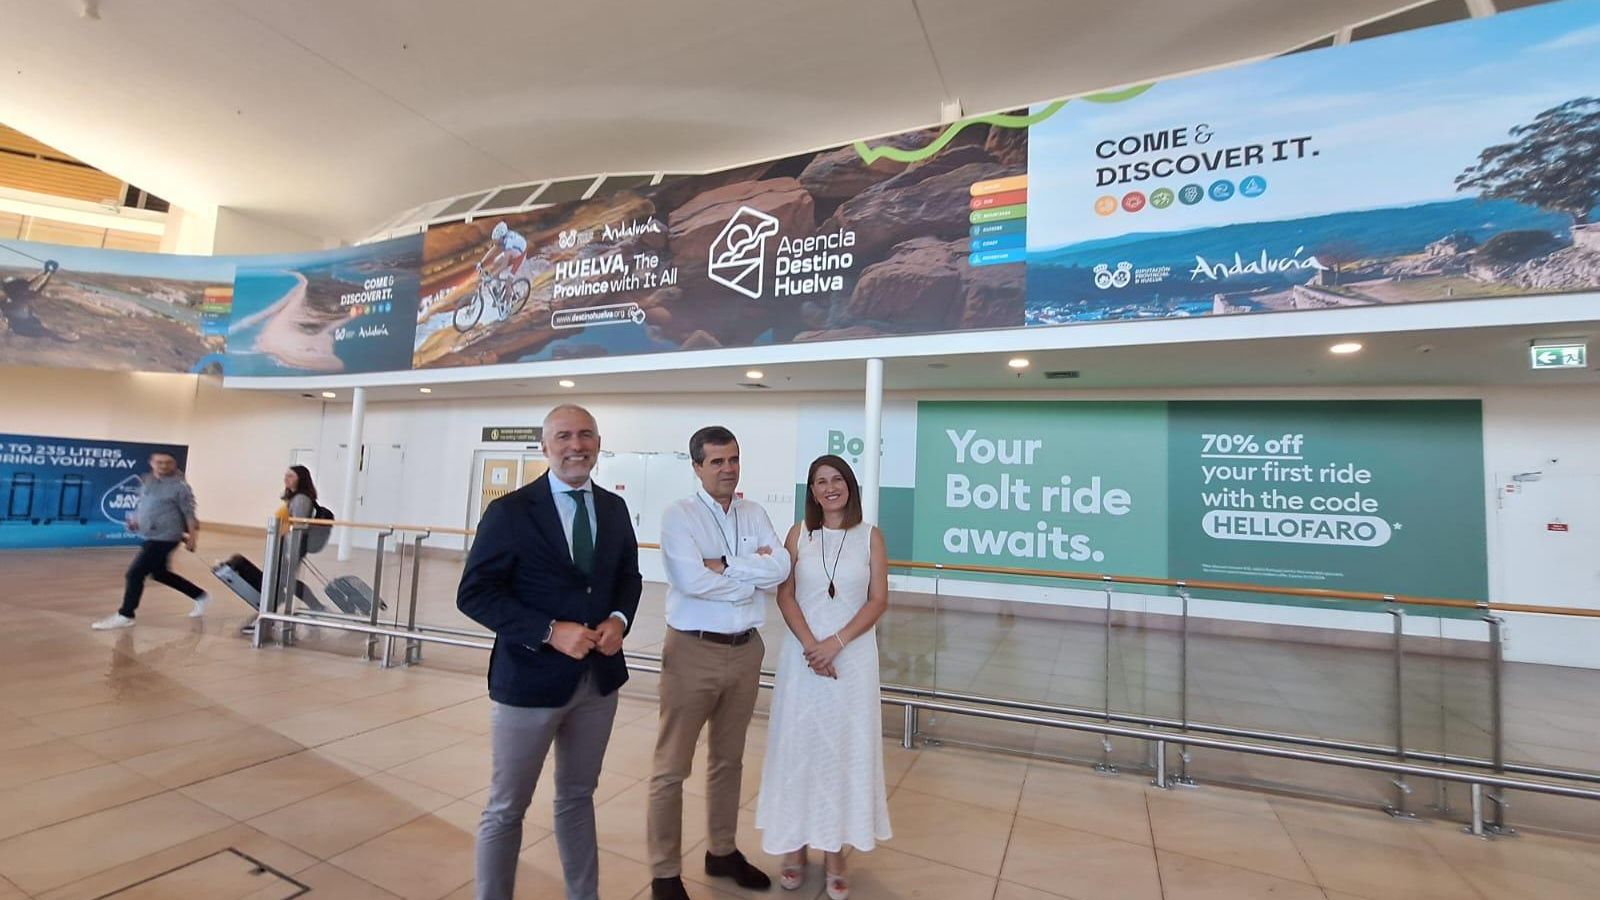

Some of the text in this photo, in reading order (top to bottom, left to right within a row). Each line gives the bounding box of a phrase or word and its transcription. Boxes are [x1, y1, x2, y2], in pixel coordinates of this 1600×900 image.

[1095, 123, 1215, 159] COME &
[1096, 136, 1320, 187] DISCOVER IT.
[602, 216, 661, 241] Andalucía
[777, 228, 856, 258] Agencia
[555, 253, 659, 280] HUELVA, The
[775, 251, 853, 276] Destino
[1190, 246, 1329, 281] Andalucía
[364, 276, 388, 290] COME
[553, 267, 678, 298] Province with It All
[774, 273, 844, 297] Huelva
[341, 289, 381, 305] DISCOVER
[8, 443, 32, 454] TO
[36, 445, 66, 456] 235
[70, 447, 122, 459] LITERS
[828, 430, 884, 456] Bo
[945, 429, 1042, 465] Your
[1201, 433, 1304, 454] 70% off
[0, 454, 137, 469] RING YOUR STAY
[1201, 461, 1371, 485] your first ride
[946, 473, 1131, 515] Bolt ride
[1201, 487, 1378, 513] with the code
[943, 520, 1105, 562] awaits.
[1214, 515, 1377, 541] HELLOFARO
